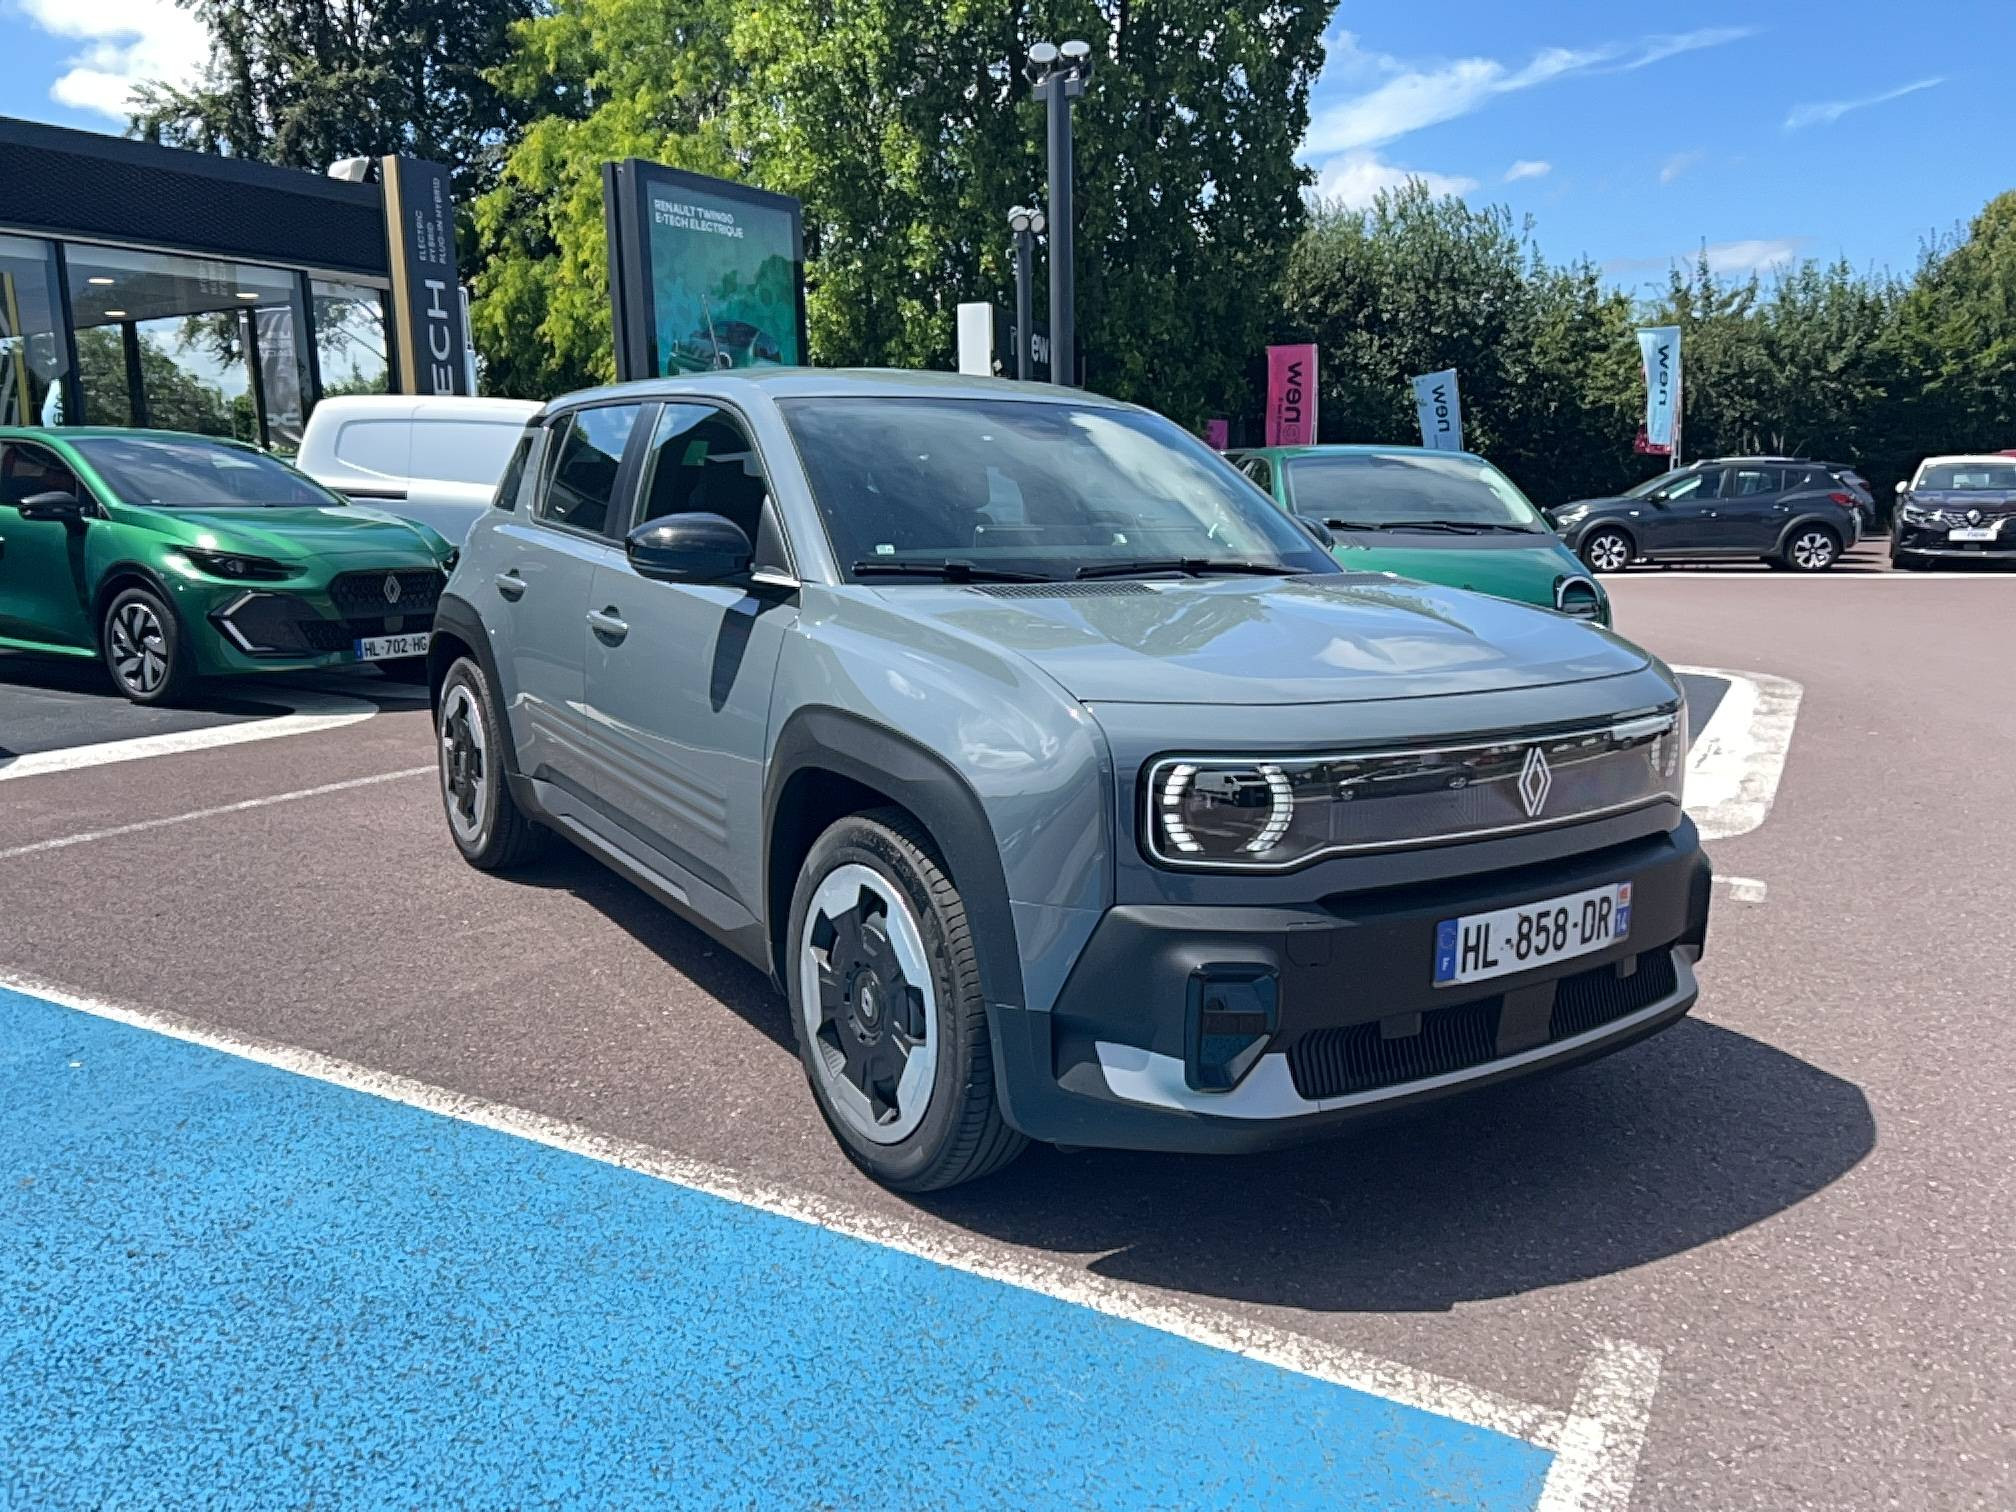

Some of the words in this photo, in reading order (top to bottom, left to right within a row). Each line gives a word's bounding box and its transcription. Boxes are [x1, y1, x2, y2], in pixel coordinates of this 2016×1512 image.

[433, 178, 442, 218] HYBRID
[655, 200, 695, 216] RENAULT
[697, 208, 734, 224] TWINGO
[416, 210, 426, 261] ELECTRIC
[656, 212, 689, 228] E-TECH
[427, 222, 436, 263] HYBRID
[1461, 896, 1612, 973] HL-858-DR
